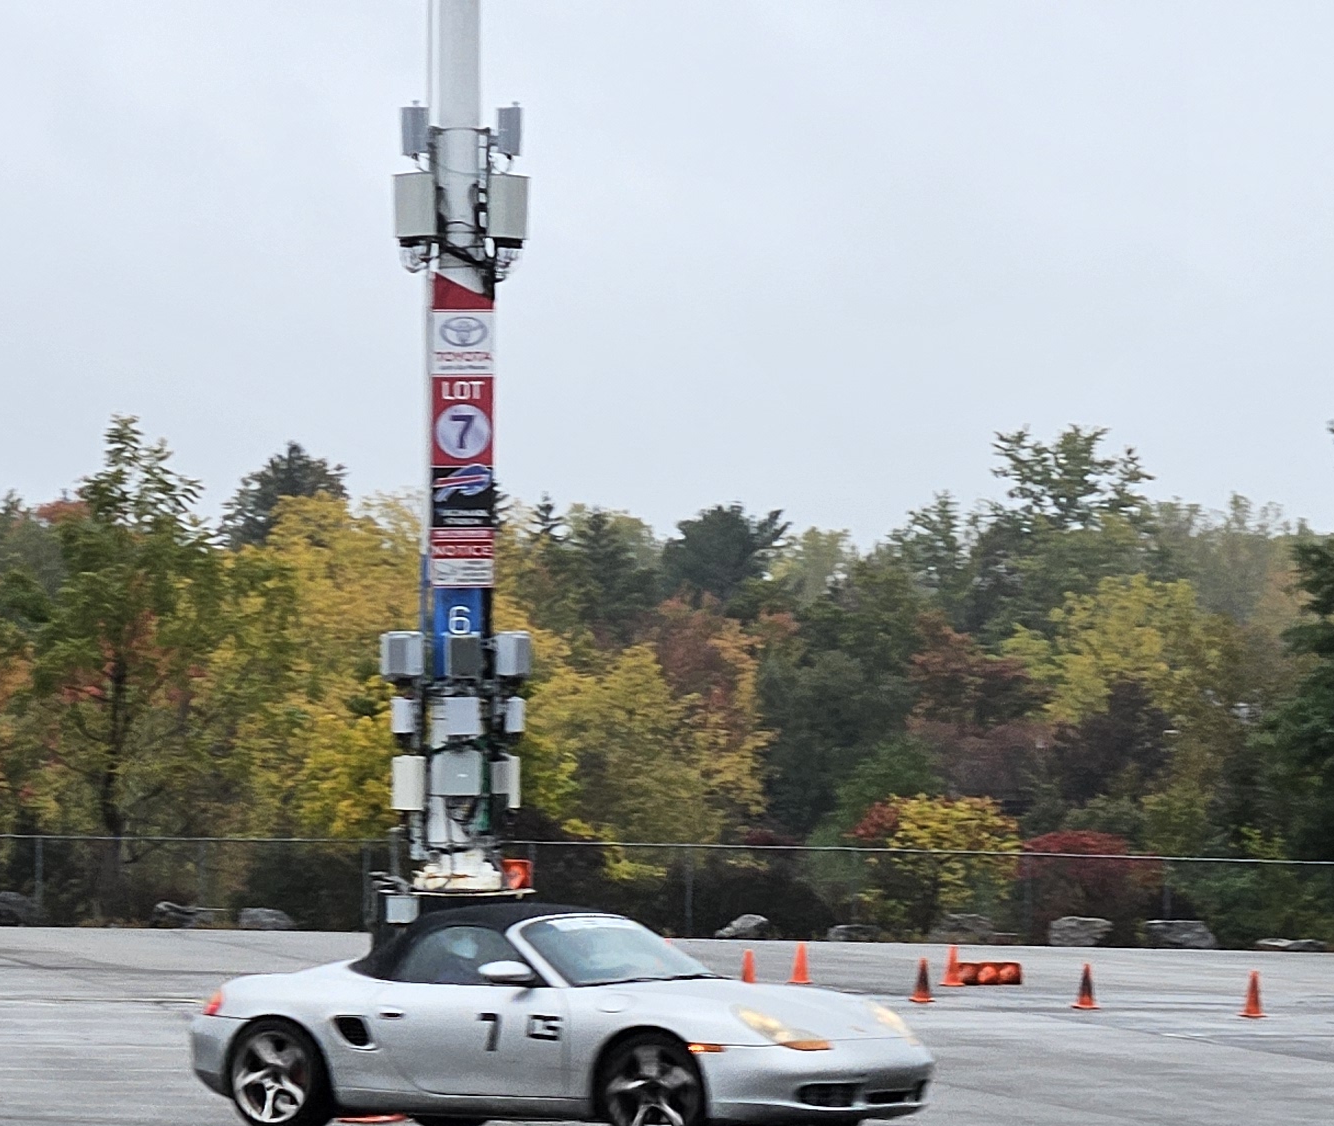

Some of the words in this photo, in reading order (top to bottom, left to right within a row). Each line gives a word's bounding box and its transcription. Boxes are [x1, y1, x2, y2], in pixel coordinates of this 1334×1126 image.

[441, 381, 485, 400] LOT
[450, 414, 476, 450] 7
[448, 605, 472, 635] 6
[475, 1012, 502, 1052] 7
